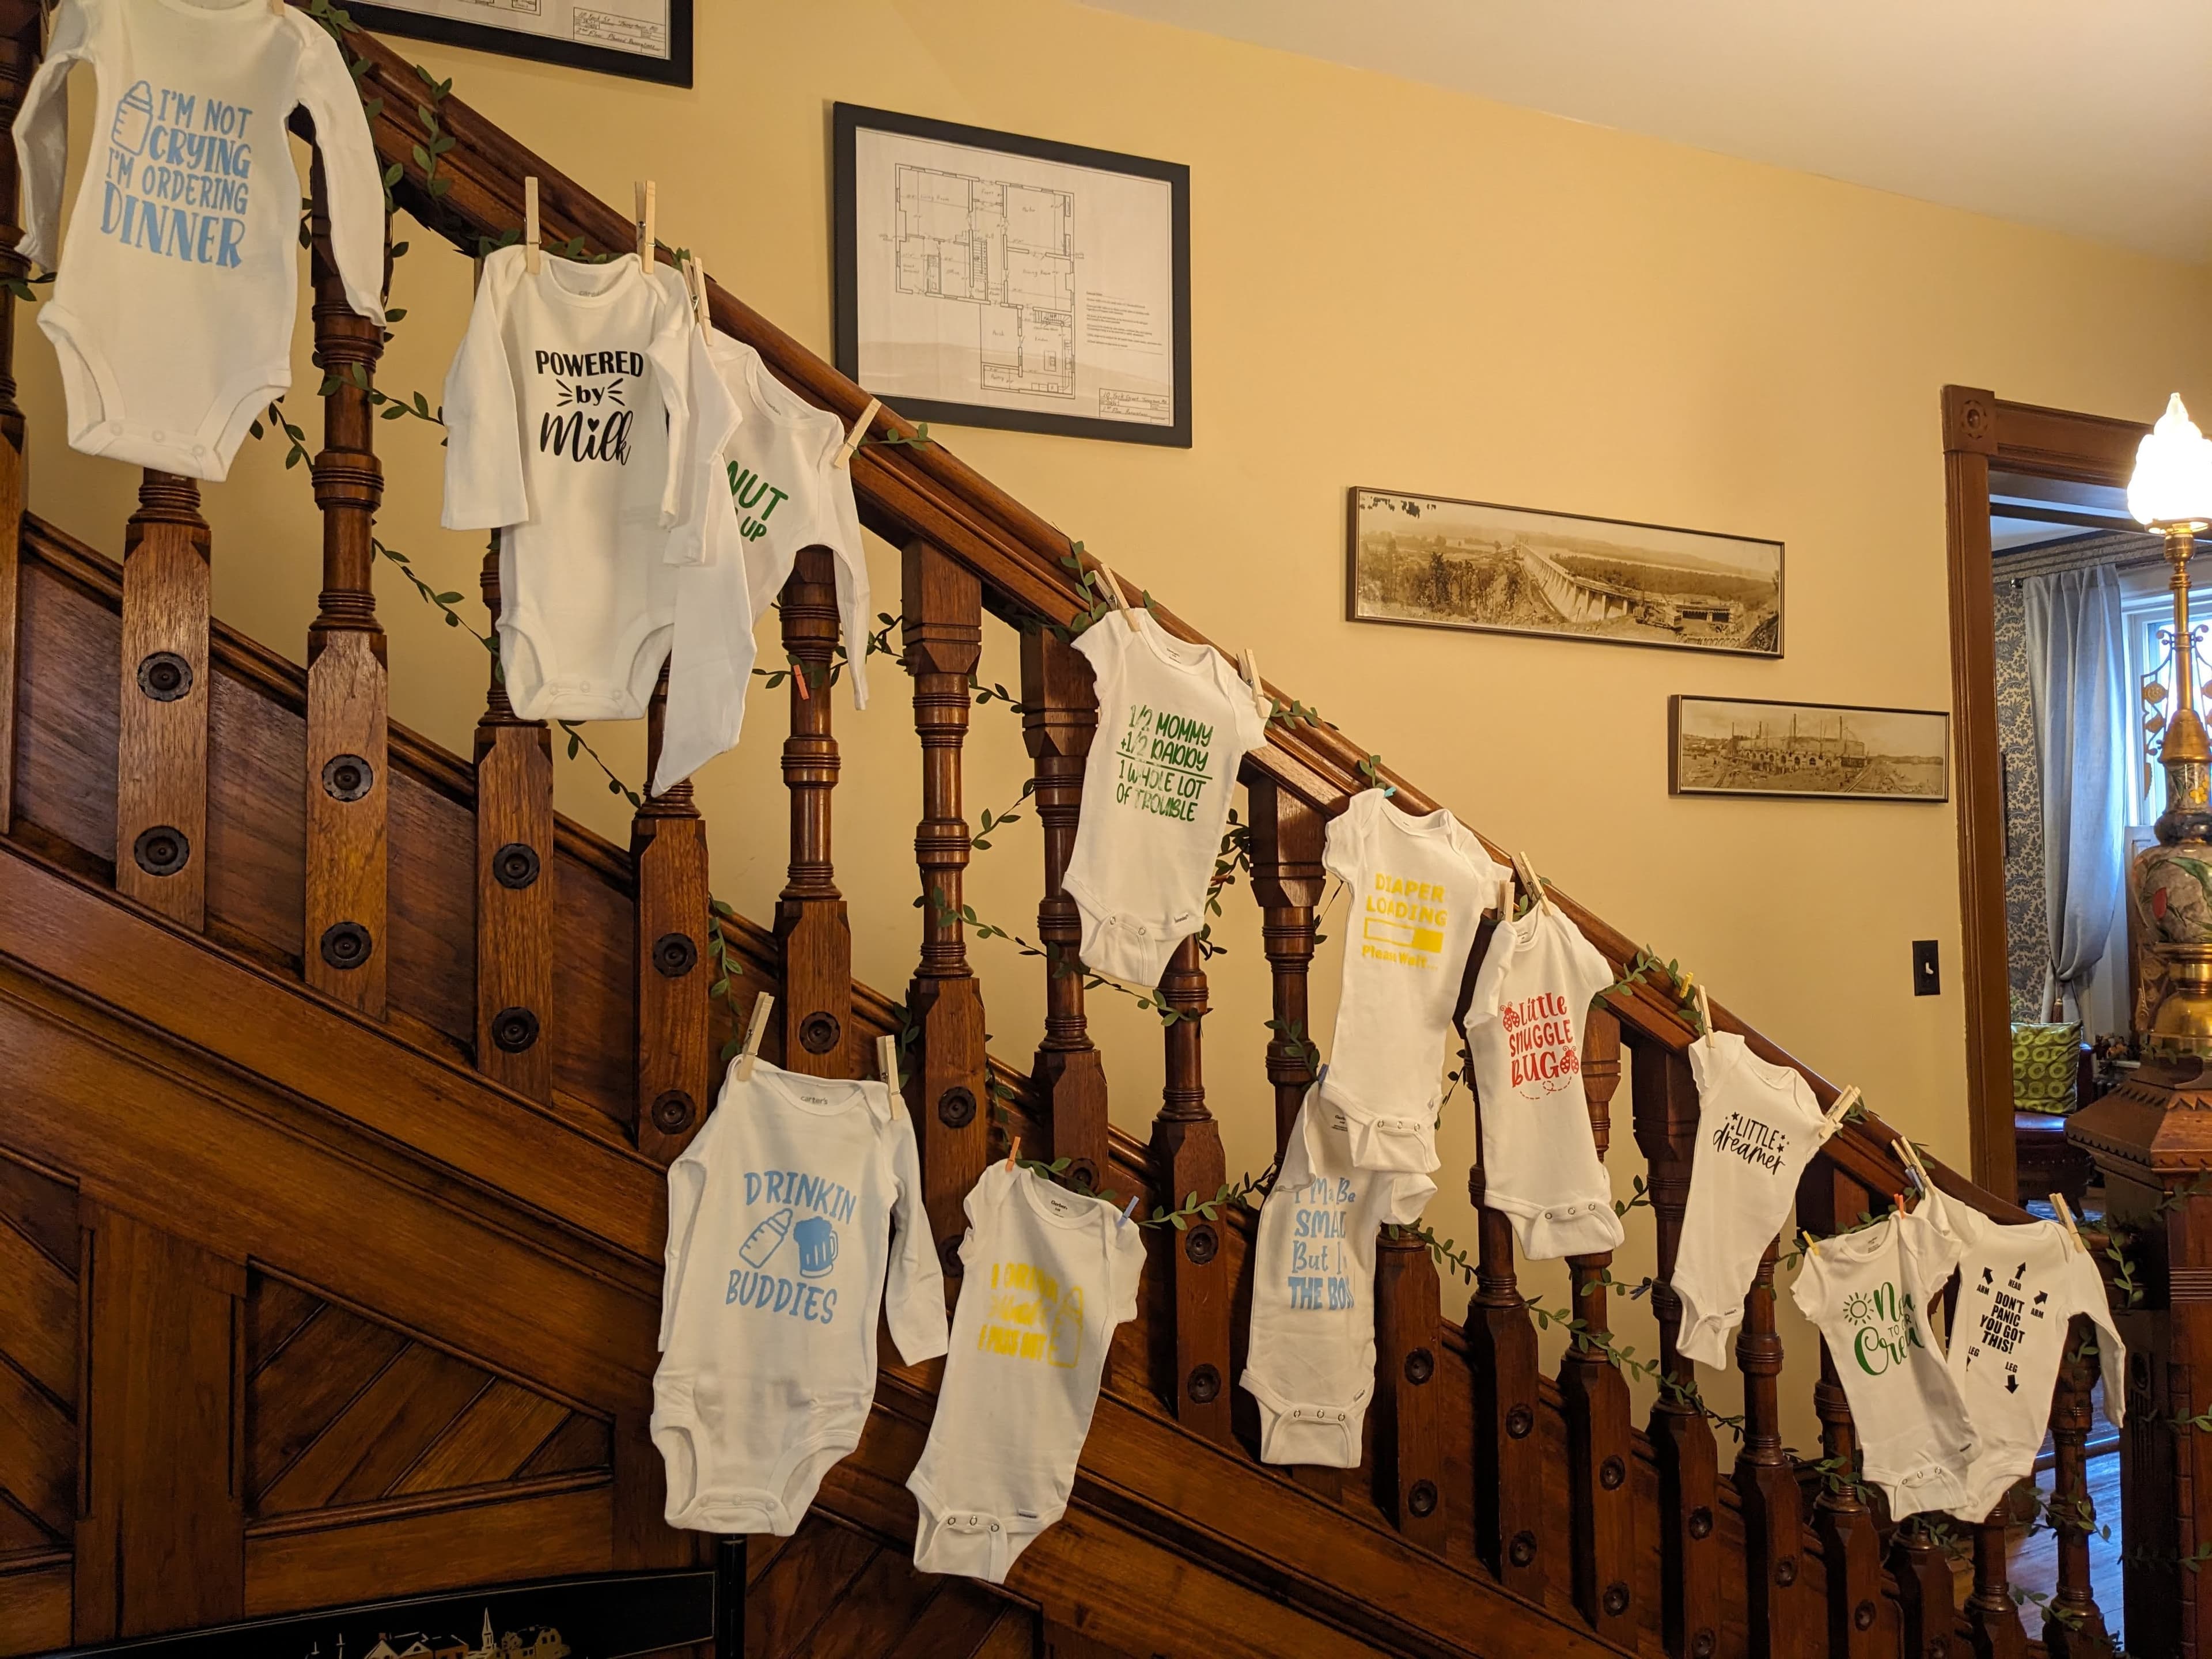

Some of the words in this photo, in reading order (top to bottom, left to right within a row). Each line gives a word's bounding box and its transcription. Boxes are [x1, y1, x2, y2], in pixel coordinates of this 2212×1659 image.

[157, 89, 195, 128] I'M
[203, 99, 253, 139] NOT
[149, 125, 251, 179] CRYING
[106, 147, 135, 189] I'M
[142, 165, 249, 215] ORDERING
[100, 180, 245, 268] DINNER
[535, 350, 643, 377] POWERED
[575, 385, 605, 406] by
[540, 410, 633, 465] Milk
[740, 516, 767, 542] UP
[1129, 704, 1153, 732] 1/2
[1155, 712, 1214, 747] MOMMY
[1150, 738, 1209, 772] DADDY
[1119, 759, 1124, 779] 1
[1177, 776, 1207, 800] LOT
[1135, 788, 1198, 821] TROUBLE
[1375, 873, 1445, 903] DIAPER
[1366, 895, 1448, 927] LOADING
[1519, 992, 1567, 1026] Little
[1512, 1051, 1560, 1088] BUG
[1713, 1122, 1786, 1175] dreamer
[1736, 1116, 1779, 1150] LITTLE
[744, 1170, 857, 1225] DRINKIN
[1292, 1240, 1328, 1274] But
[726, 1269, 837, 1324] BUDDIES
[1288, 1276, 1323, 1309] THE
[1976, 1284, 1990, 1296] ARM
[2008, 1278, 2021, 1291] HEAD
[1991, 1304, 2021, 1327] PANIC
[1995, 1291, 2025, 1313] DON'T
[2031, 1308, 2044, 1319] ARM
[1980, 1314, 2003, 1334] YOU
[2003, 1325, 2025, 1343] GOT
[1982, 1330, 2014, 1354] THIS!
[1968, 1346, 1980, 1357] LEG
[2005, 1361, 2018, 1373] LEG
